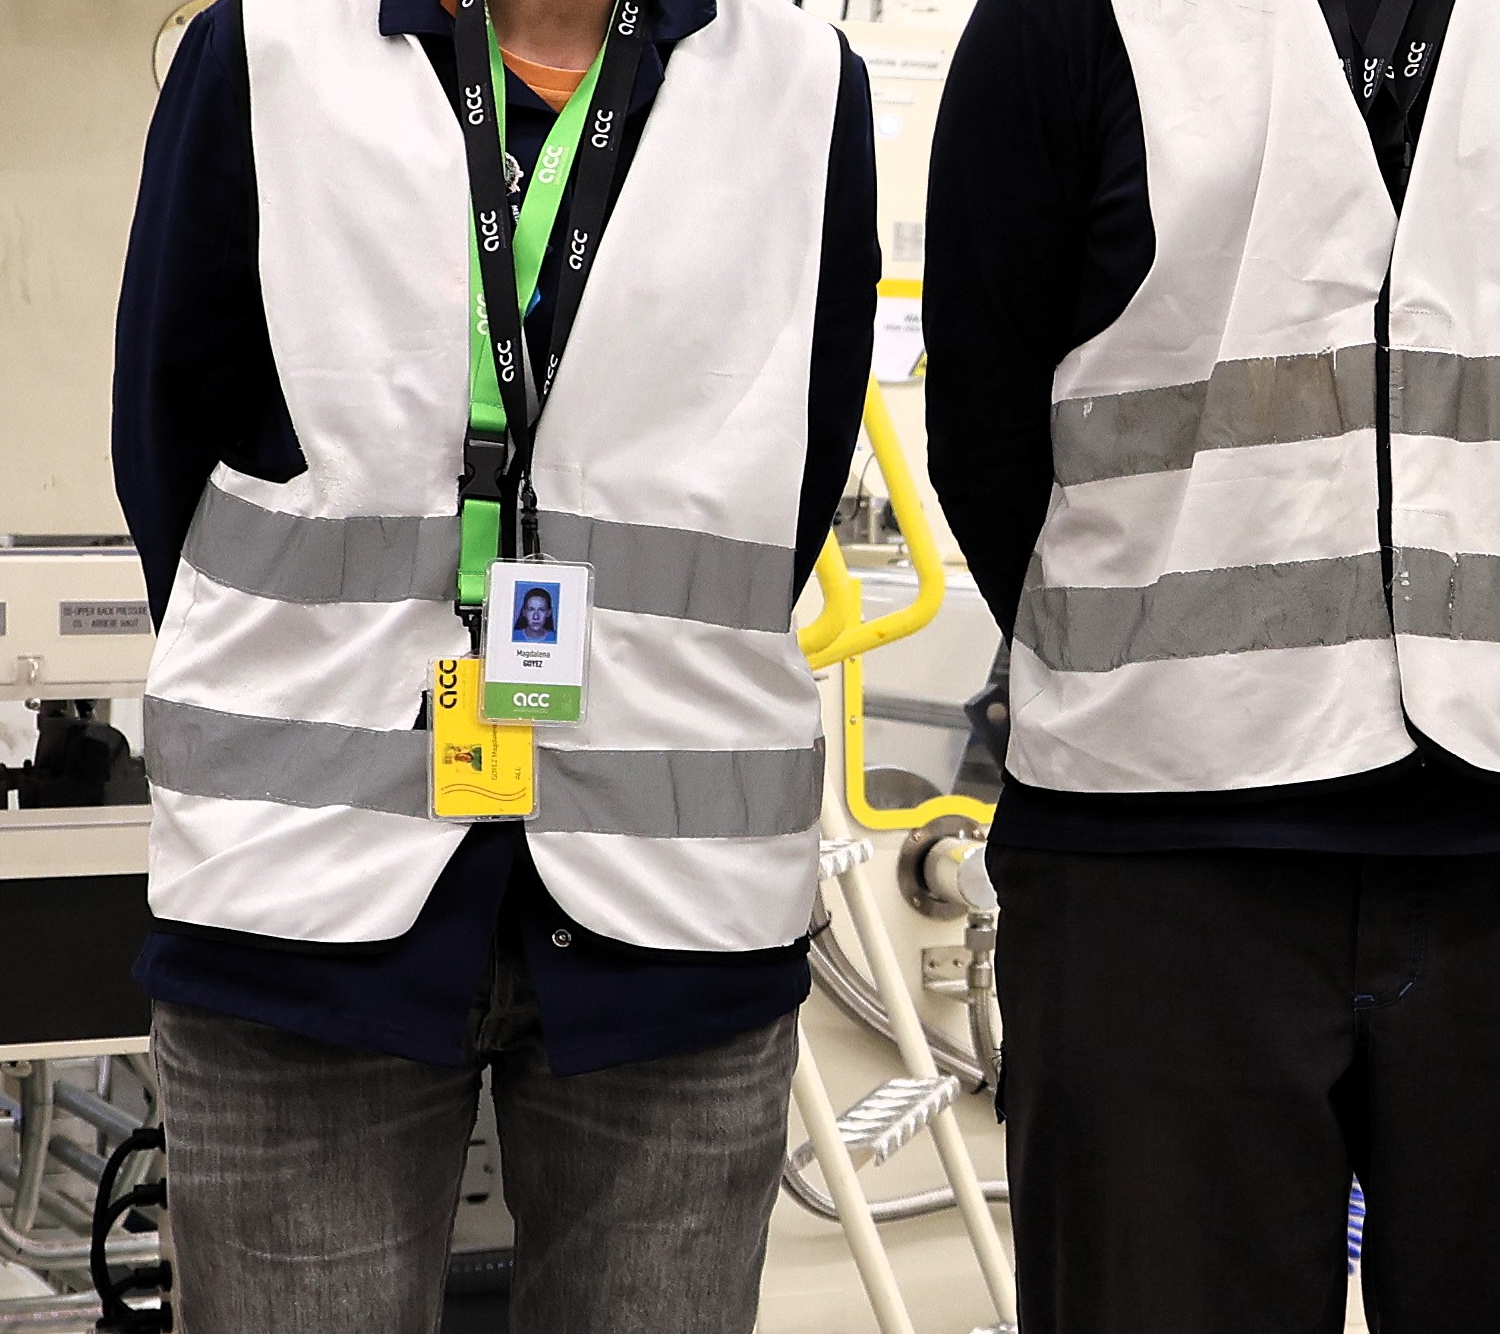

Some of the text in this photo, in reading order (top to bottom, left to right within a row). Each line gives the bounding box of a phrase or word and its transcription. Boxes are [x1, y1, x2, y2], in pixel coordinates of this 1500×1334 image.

[618, 1, 639, 35] acc
[1363, 58, 1378, 98] acc
[1404, 41, 1426, 77] acc
[465, 84, 484, 125] acc
[591, 109, 614, 148] acc
[538, 144, 564, 184] acc
[480, 210, 500, 252] acc
[569, 229, 588, 270] acc
[497, 339, 515, 382] acc
[516, 649, 551, 658] Magdalena
[522, 660, 543, 668] GOYEZ
[439, 659, 457, 709] acc
[513, 692, 550, 707] acc
